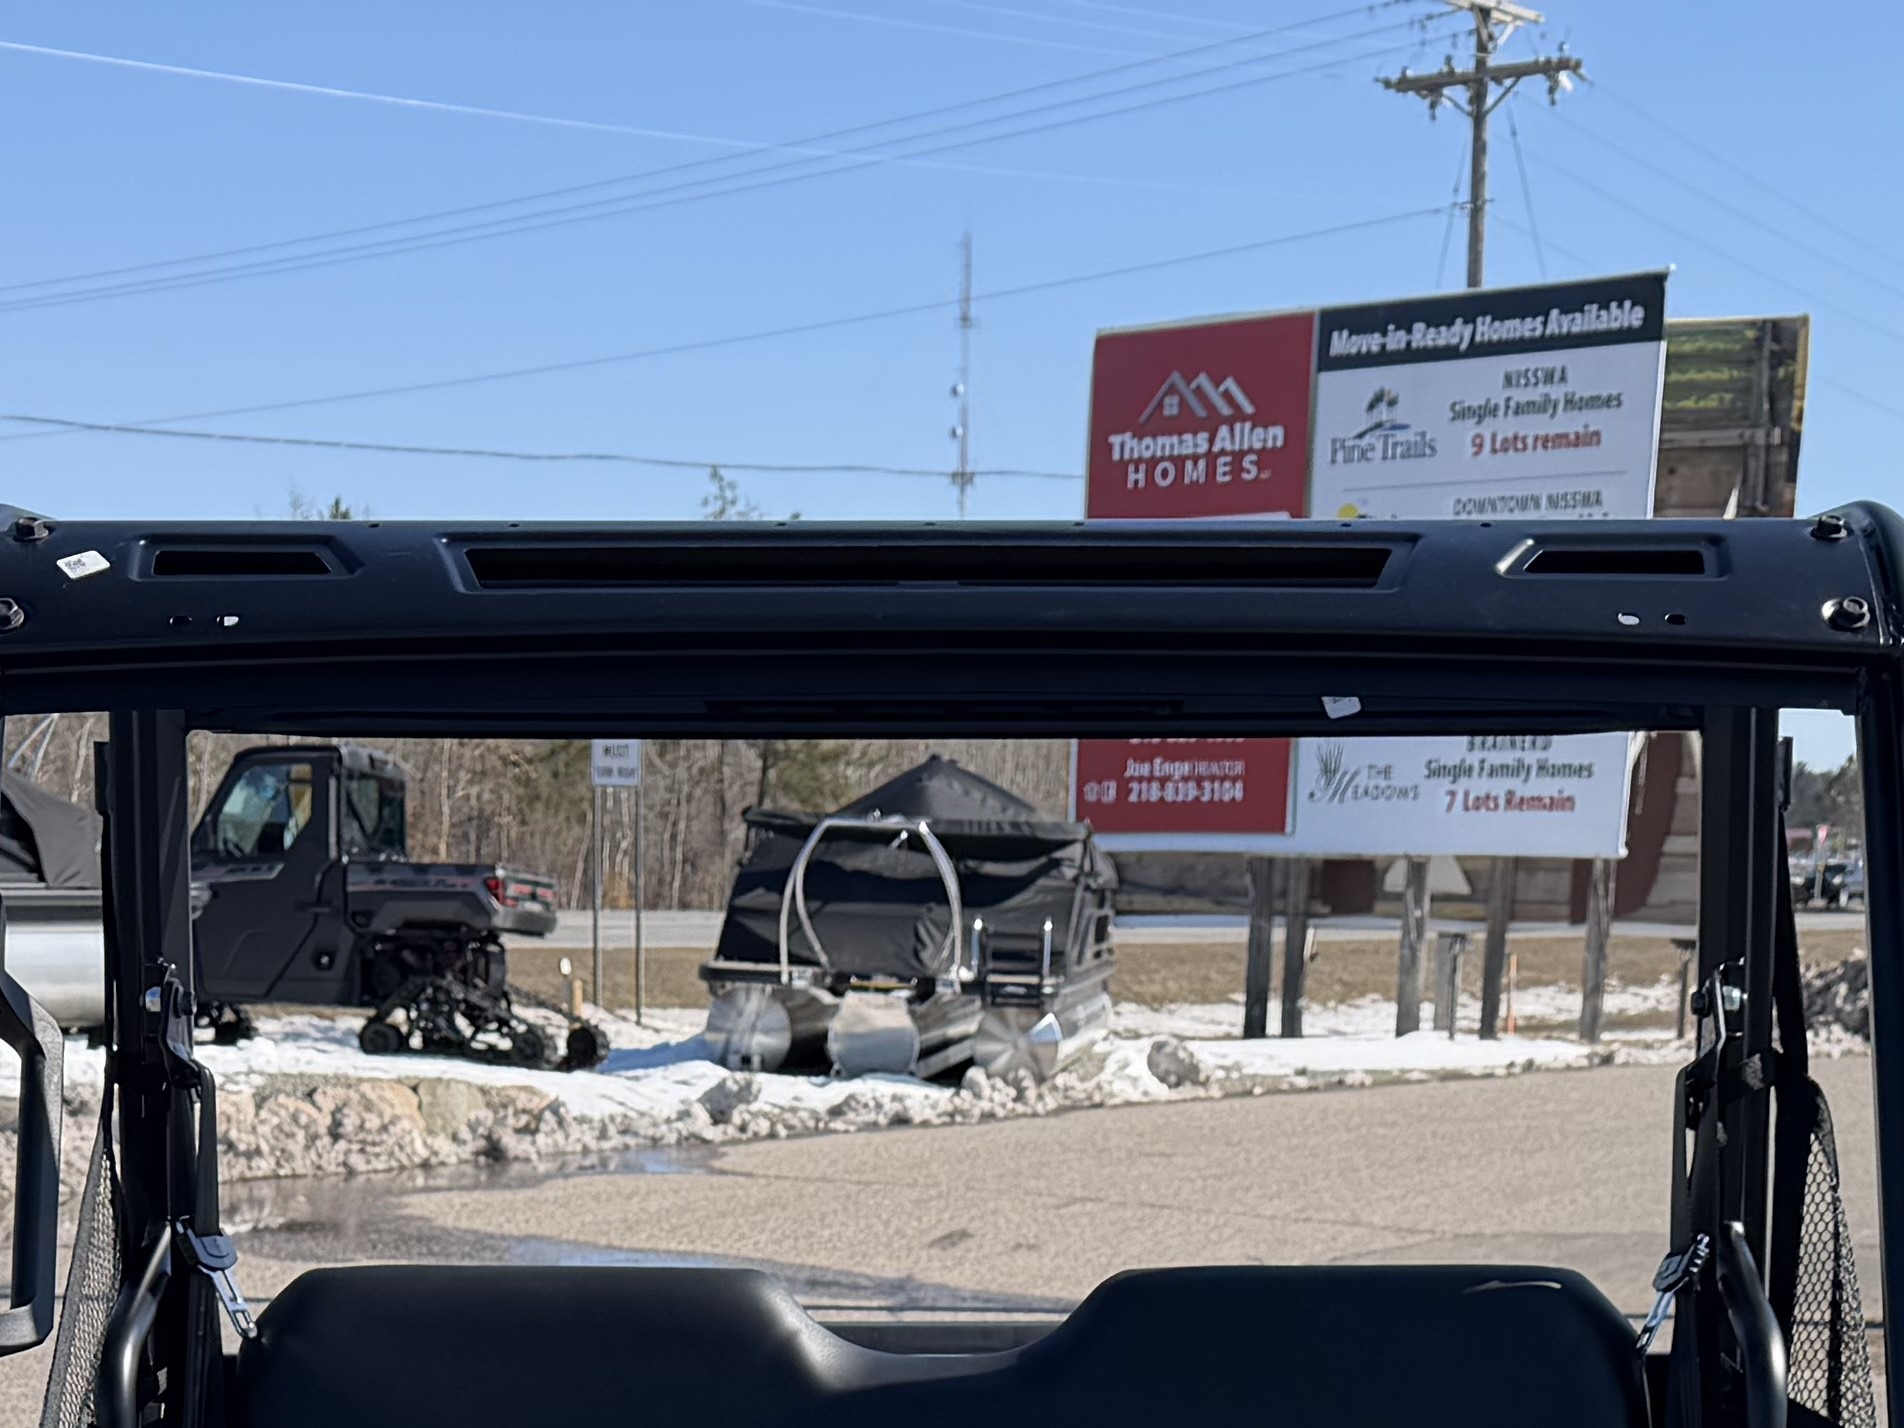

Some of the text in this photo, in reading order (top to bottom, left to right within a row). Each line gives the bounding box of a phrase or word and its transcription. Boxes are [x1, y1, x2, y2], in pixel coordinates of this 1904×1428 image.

[1329, 300, 1645, 357] Move-in-Ready Homes Available
[1448, 391, 1623, 425] Single Family Homes
[1108, 421, 1285, 461] Thomas Allen
[1376, 430, 1438, 461] Trails
[1471, 423, 1602, 457] 9 Lots remain
[1127, 453, 1259, 490] HOMES
[1424, 757, 1595, 784] Single Family Homes
[1463, 789, 1500, 812] Lots
[1504, 788, 1576, 812] Remain
